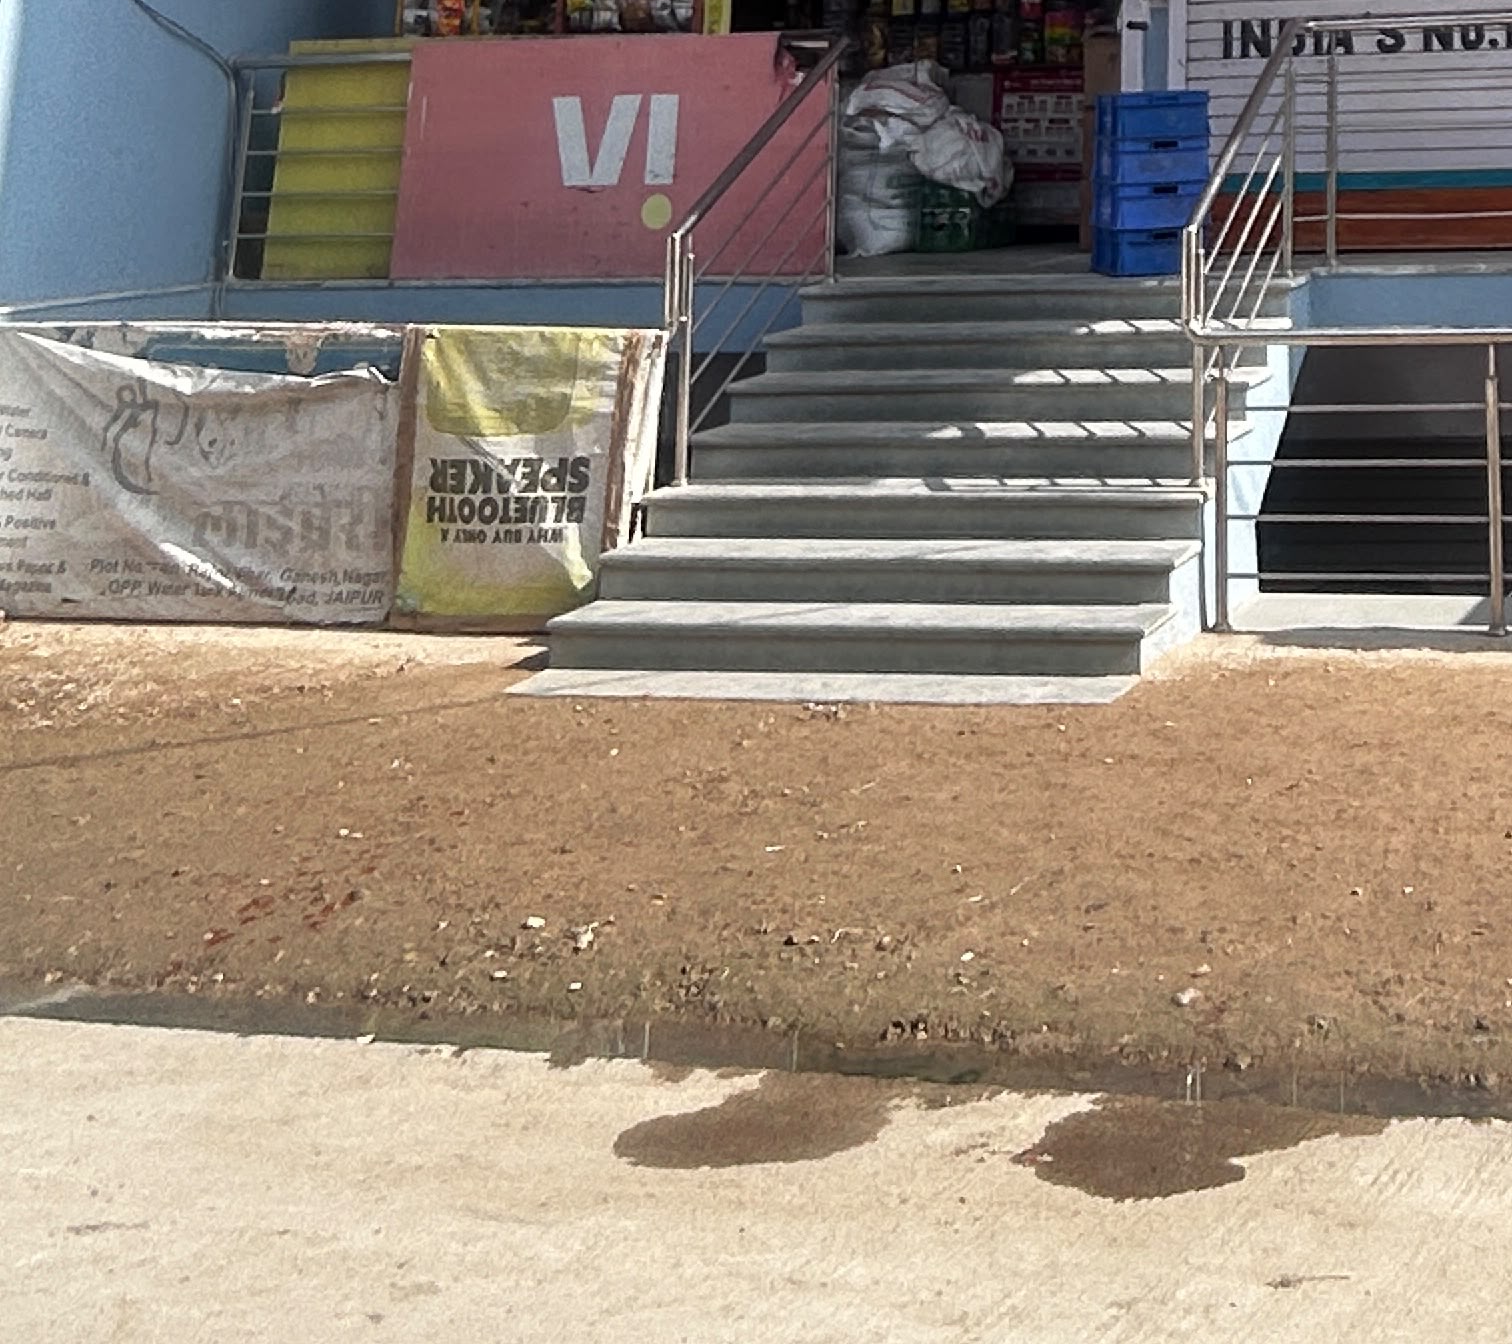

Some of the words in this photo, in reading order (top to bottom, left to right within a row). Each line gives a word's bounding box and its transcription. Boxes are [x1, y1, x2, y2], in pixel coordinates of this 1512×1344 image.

[430, 456, 591, 494] SPEAKER
[426, 496, 587, 525] BLUETOOTH
[491, 527, 522, 544] BUY
[527, 526, 564, 544] WHY
